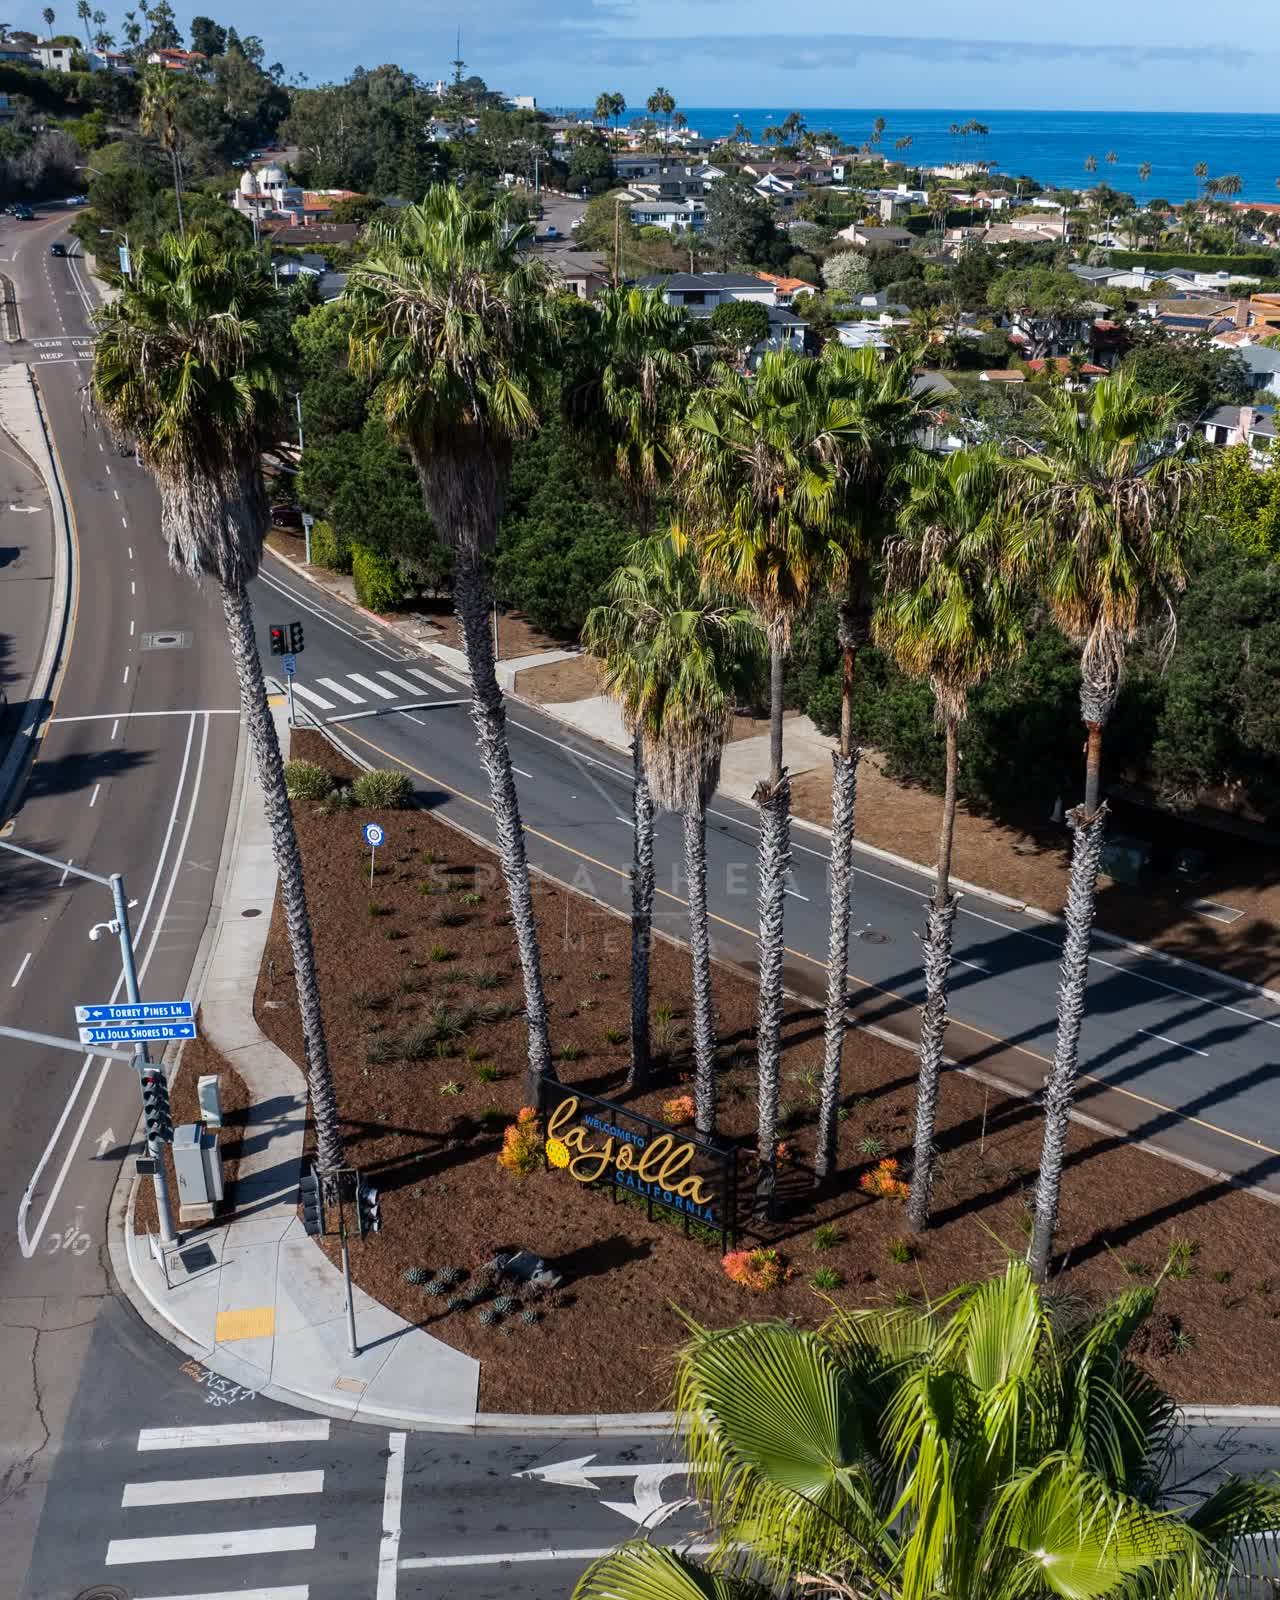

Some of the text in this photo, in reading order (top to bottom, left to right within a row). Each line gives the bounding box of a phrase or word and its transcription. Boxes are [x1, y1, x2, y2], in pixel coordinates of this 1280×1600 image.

[109, 1005, 185, 1018] TORREY PINES LN.
[95, 1027, 176, 1040] LA JOLLA SHORES DR.
[584, 1114, 645, 1148] WELCOME TO
[615, 1170, 714, 1221] CALIFORNIA
